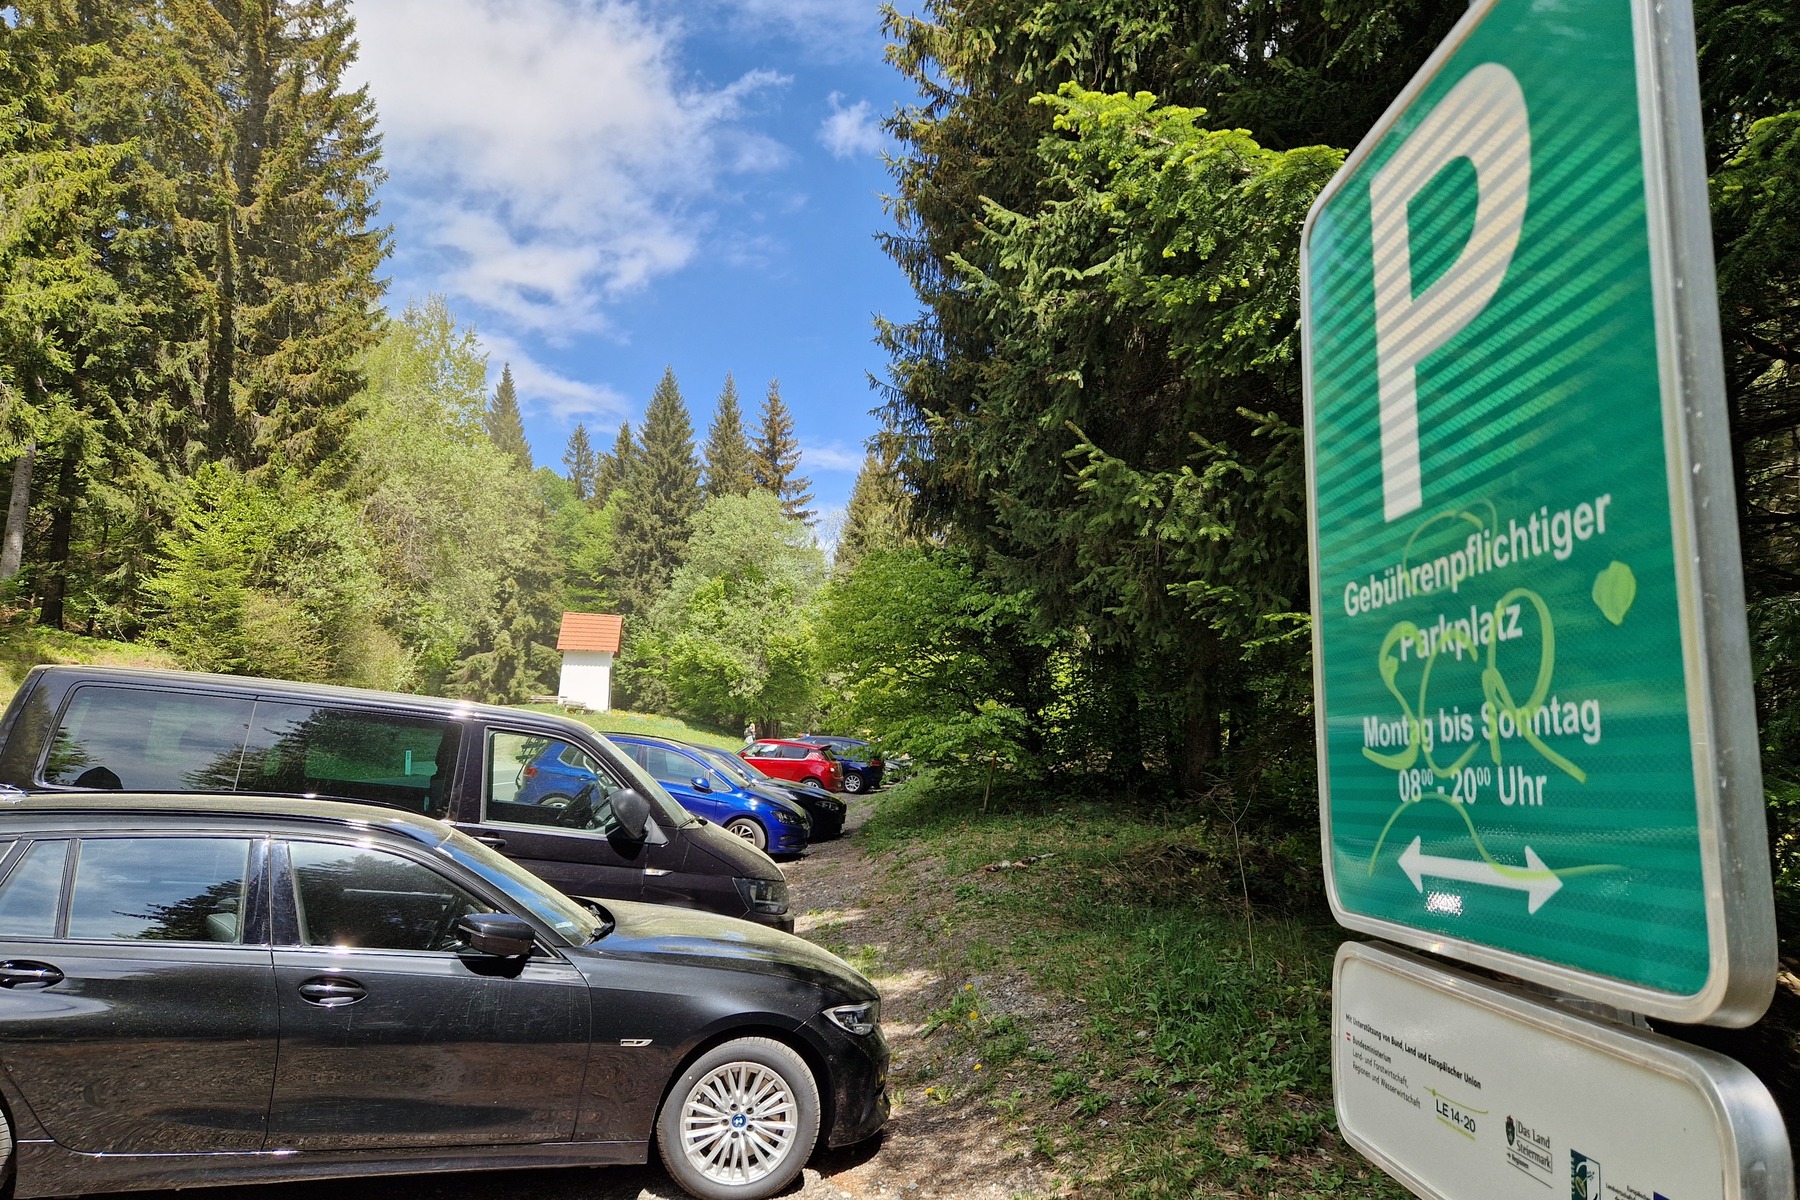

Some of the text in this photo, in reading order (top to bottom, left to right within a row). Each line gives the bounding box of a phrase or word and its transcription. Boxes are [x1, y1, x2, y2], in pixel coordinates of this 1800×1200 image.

[1369, 62, 1531, 523] P
[1343, 493, 1612, 617] Gebührenpflichtiger
[1400, 603, 1523, 662] Parkplatz
[1362, 695, 1601, 754] Montag bis Sonntag
[1497, 765, 1548, 806] Uhr
[1382, 1033, 1391, 1043] von
[1405, 1043, 1417, 1056] Land
[1417, 1051, 1427, 1062] und
[1428, 1054, 1463, 1079] Europäischer
[1464, 1072, 1482, 1090] Union
[1435, 1098, 1449, 1118] LE
[1517, 1121, 1550, 1149] Das Land
[1516, 1139, 1551, 1168] Steiermark
